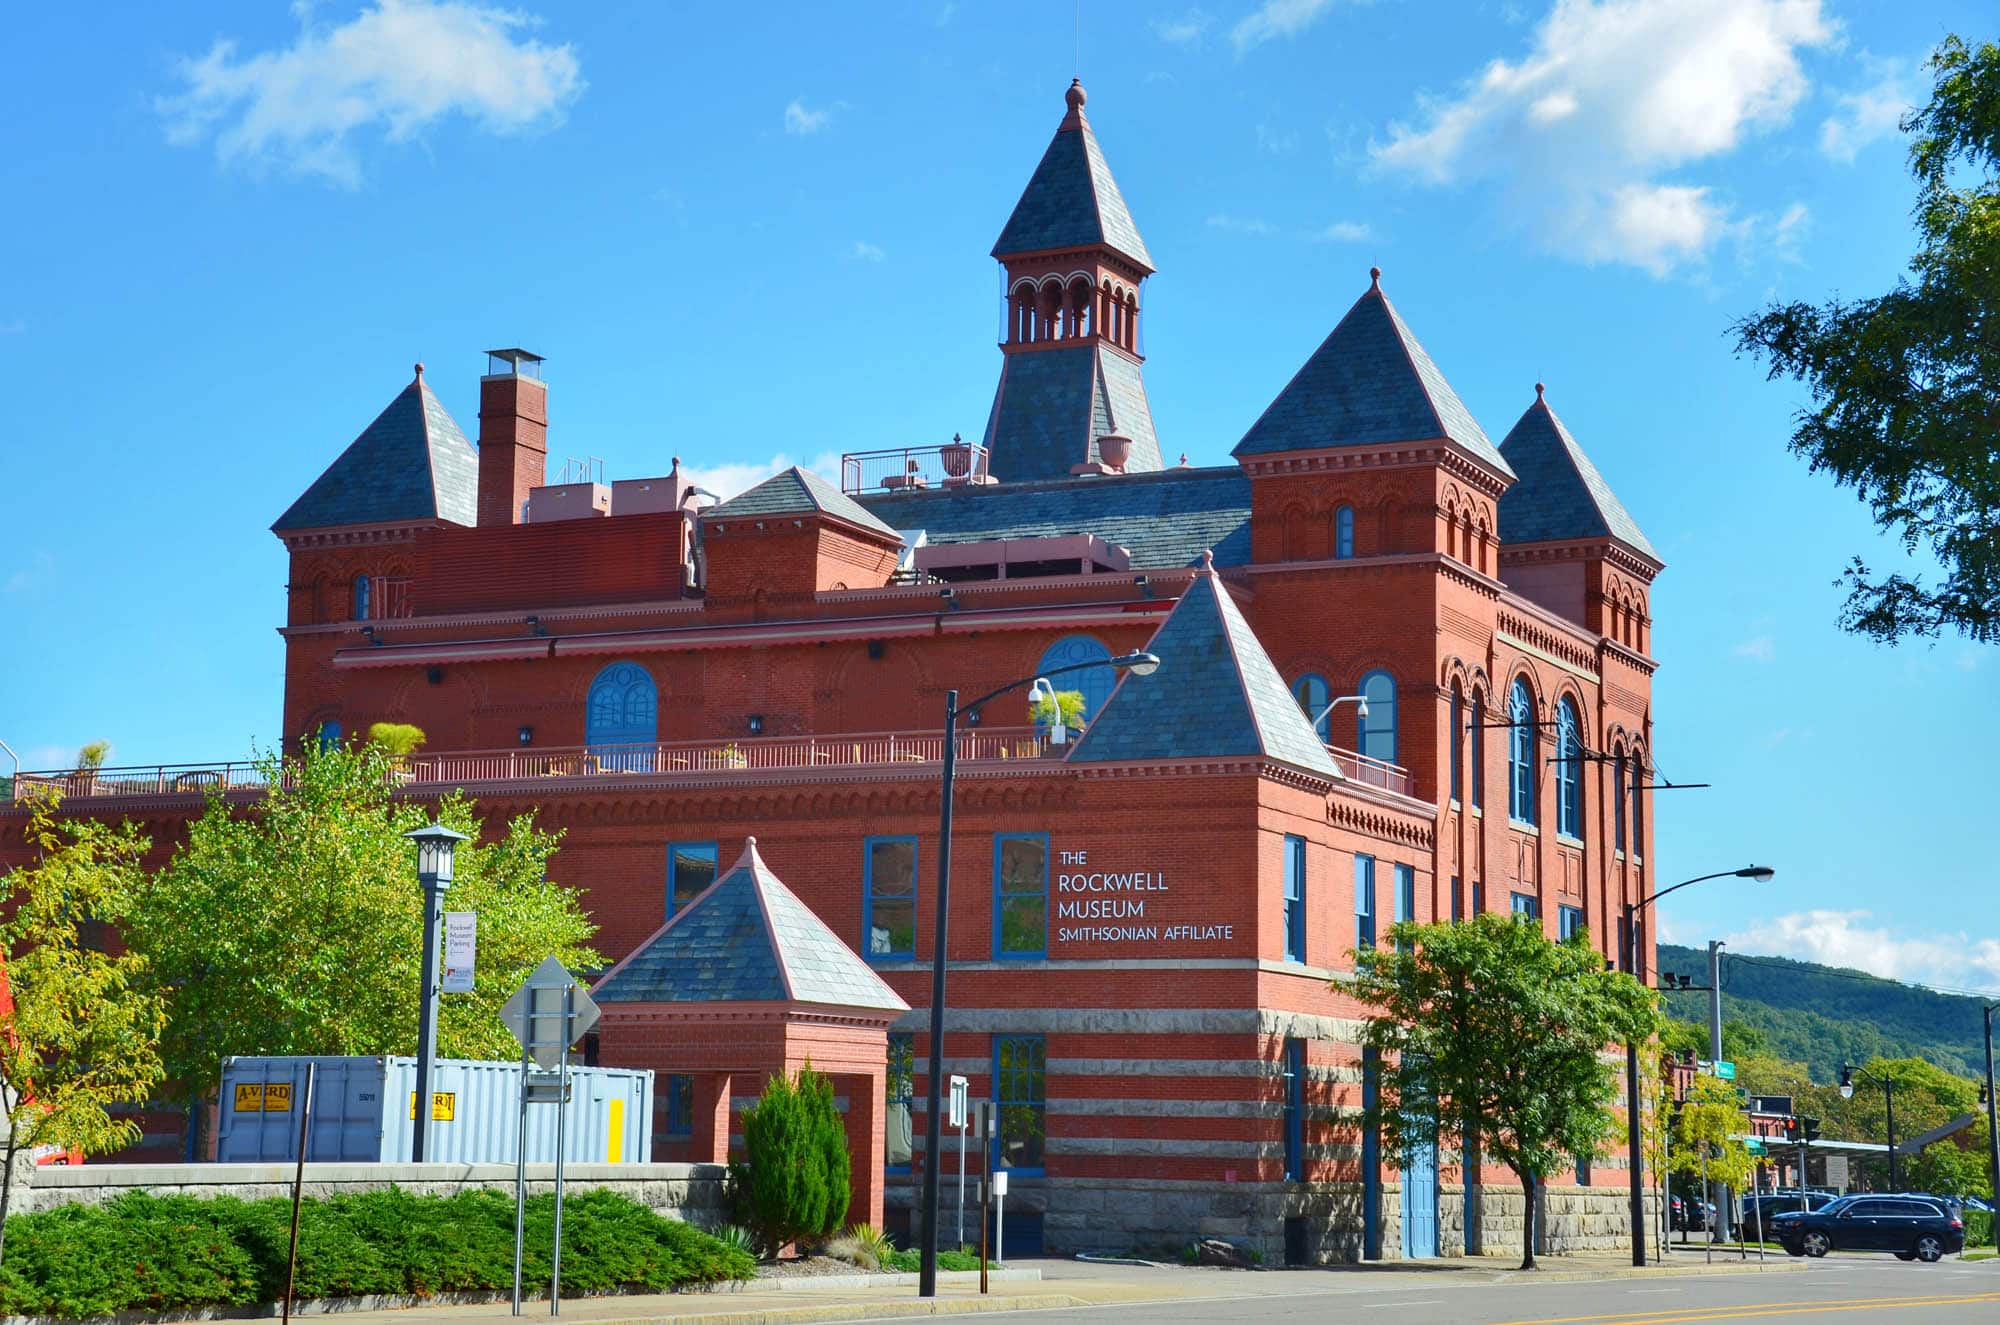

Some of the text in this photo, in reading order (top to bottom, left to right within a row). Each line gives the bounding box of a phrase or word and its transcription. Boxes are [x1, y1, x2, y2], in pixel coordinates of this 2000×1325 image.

[1059, 851, 1087, 865] THE
[1058, 872, 1169, 893] ROCKWELL
[1058, 900, 1144, 919] MUSEUM
[1058, 925, 1233, 942] SMITHSONIAN AFFILIATE
